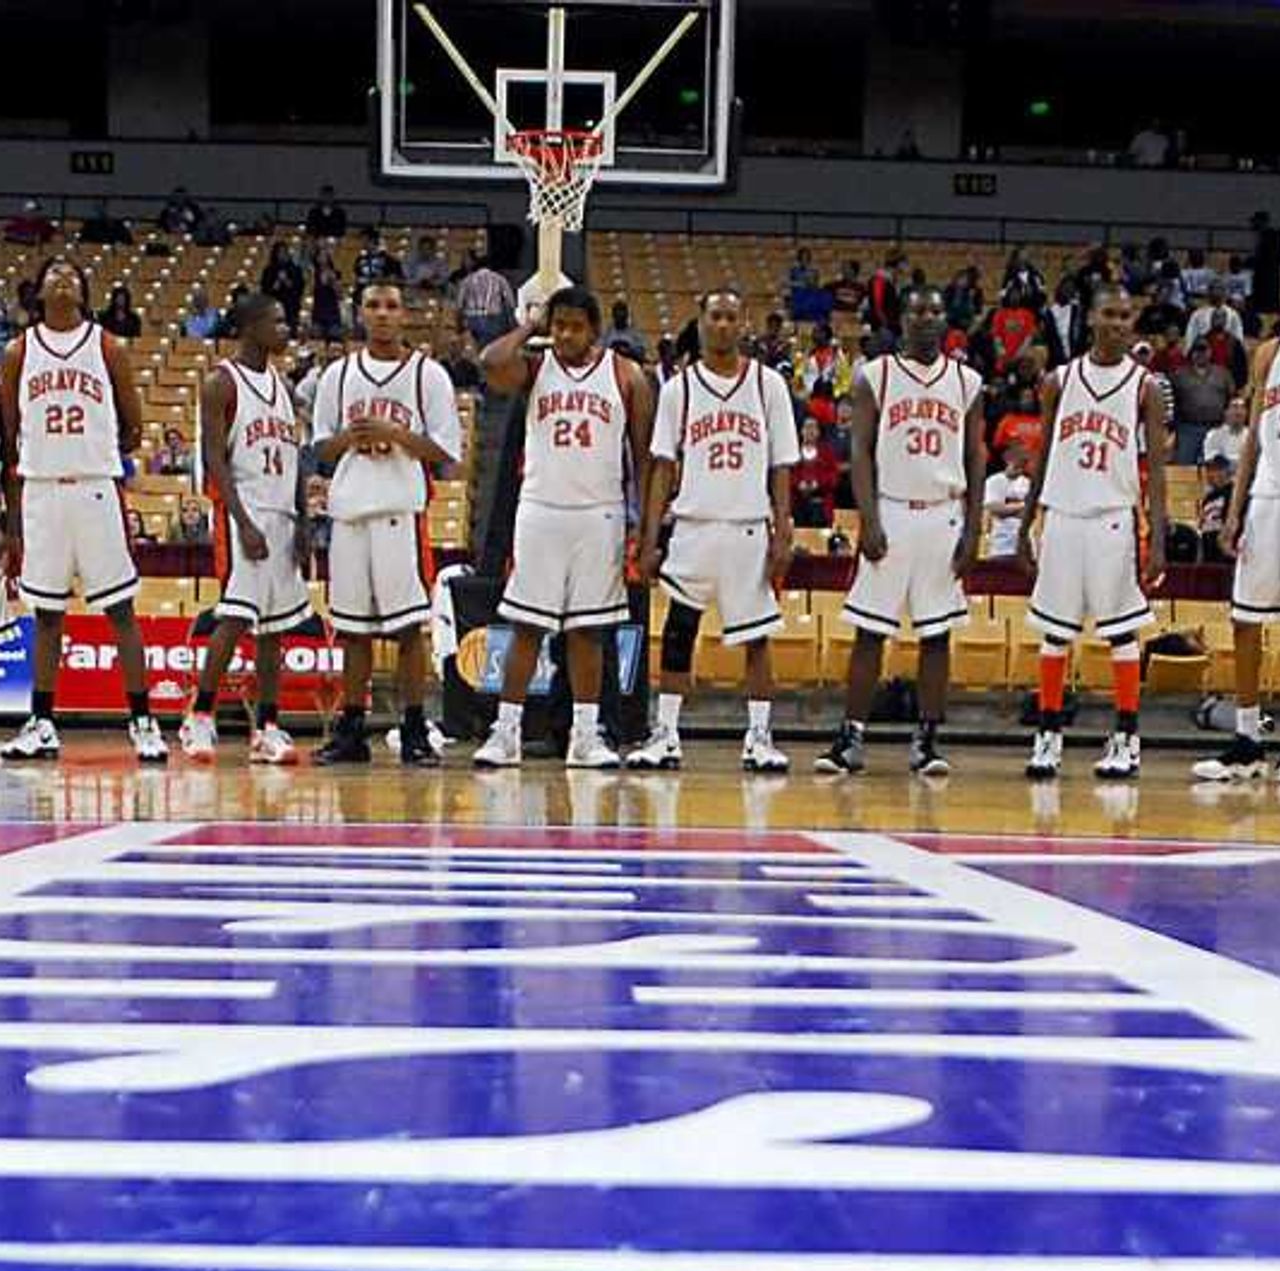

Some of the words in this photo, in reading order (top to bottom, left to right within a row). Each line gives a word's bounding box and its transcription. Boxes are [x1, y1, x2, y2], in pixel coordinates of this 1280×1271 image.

[28, 369, 102, 404] BRAVES
[45, 404, 85, 434] 22
[537, 390, 611, 424] BRAVES
[889, 398, 960, 433] BRAVES
[553, 418, 592, 448] 24
[689, 411, 762, 446] BRAVES
[906, 426, 942, 457] 30
[1059, 408, 1129, 451] BRAVES
[263, 446, 284, 476] 14
[708, 441, 744, 471] 25
[1078, 441, 1109, 472] 31
